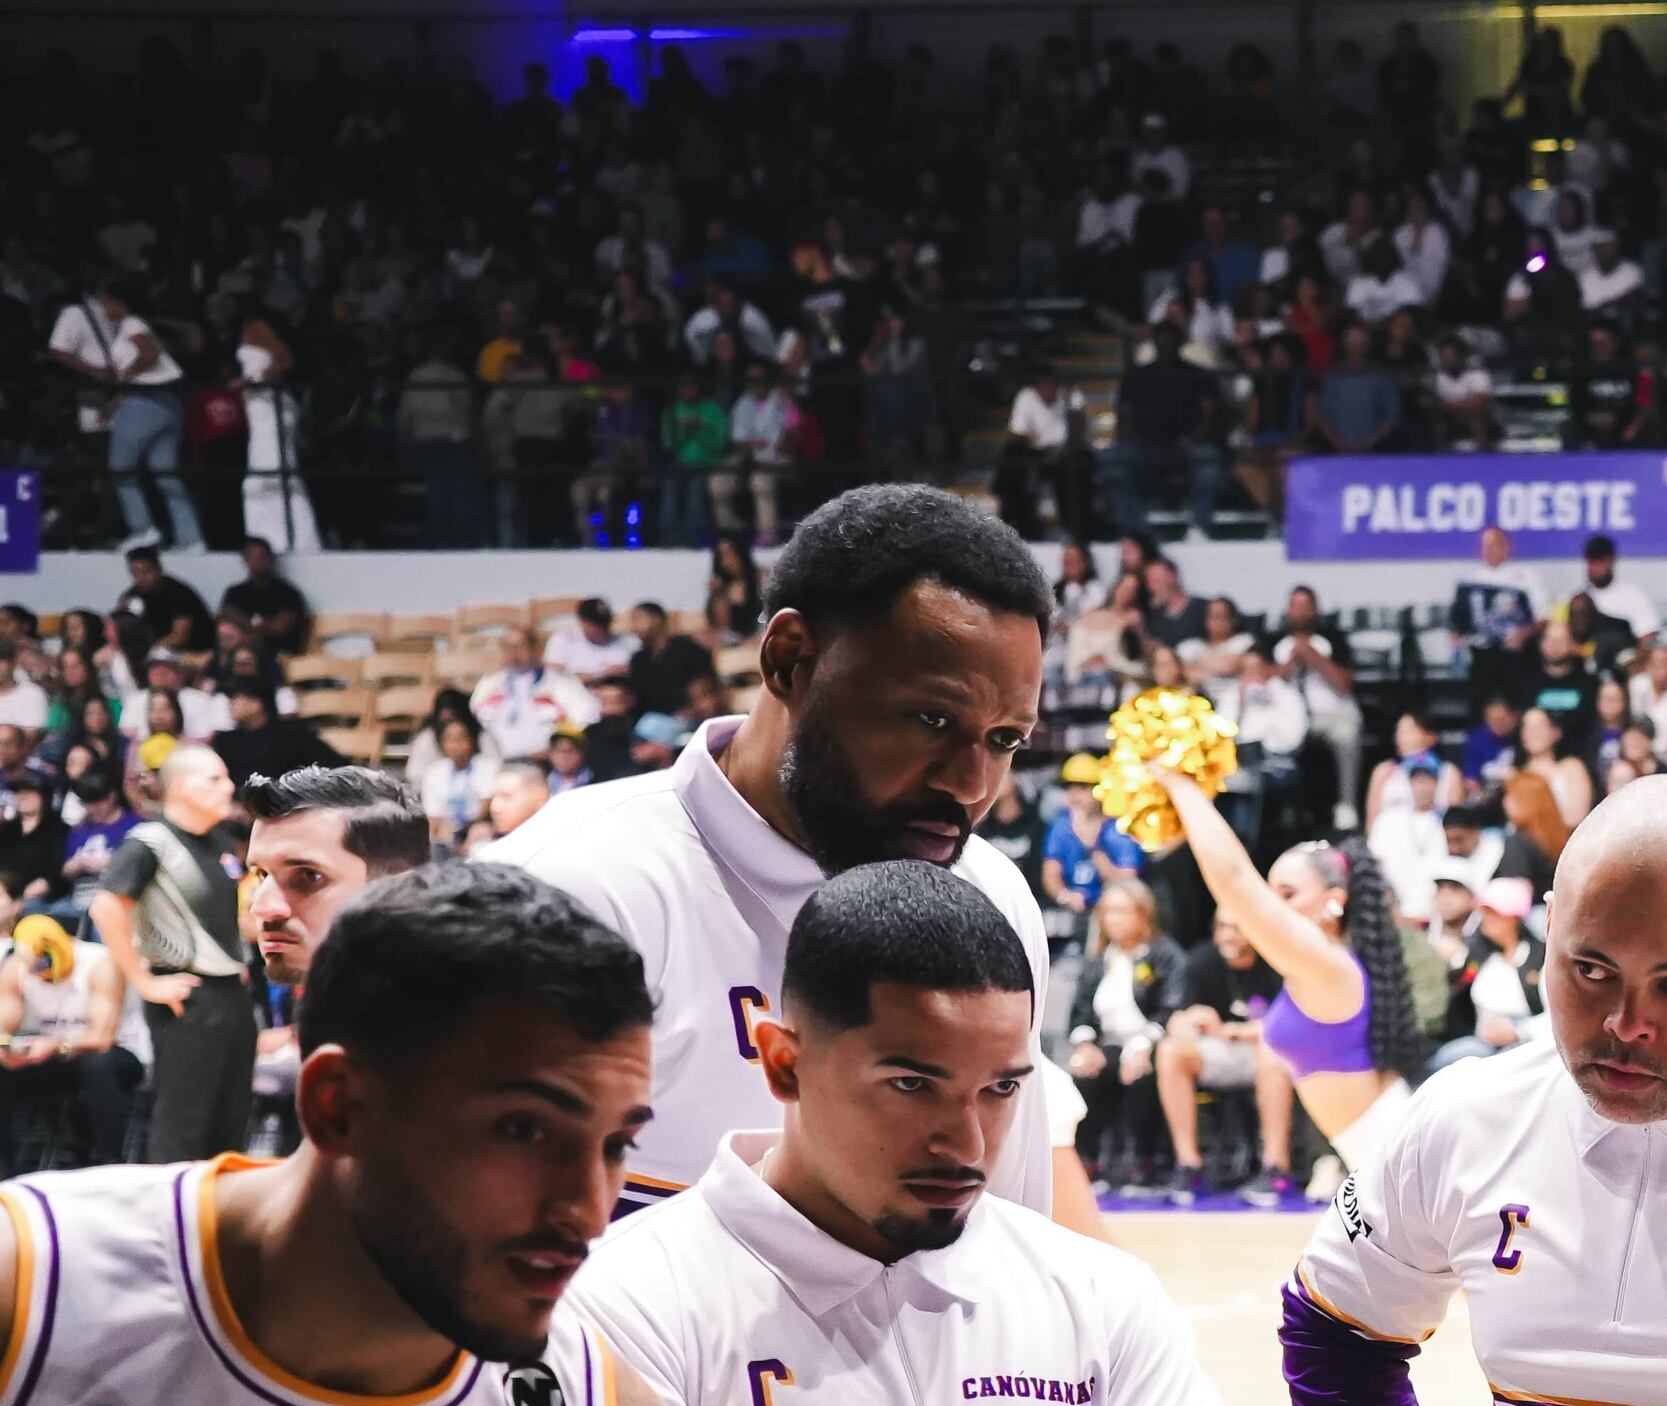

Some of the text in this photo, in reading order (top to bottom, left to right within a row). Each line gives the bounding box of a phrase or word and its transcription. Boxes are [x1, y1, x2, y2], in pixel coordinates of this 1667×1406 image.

[1341, 481, 1637, 533] PALCO OESTE
[727, 985, 770, 1065] C
[1492, 1203, 1532, 1276] C
